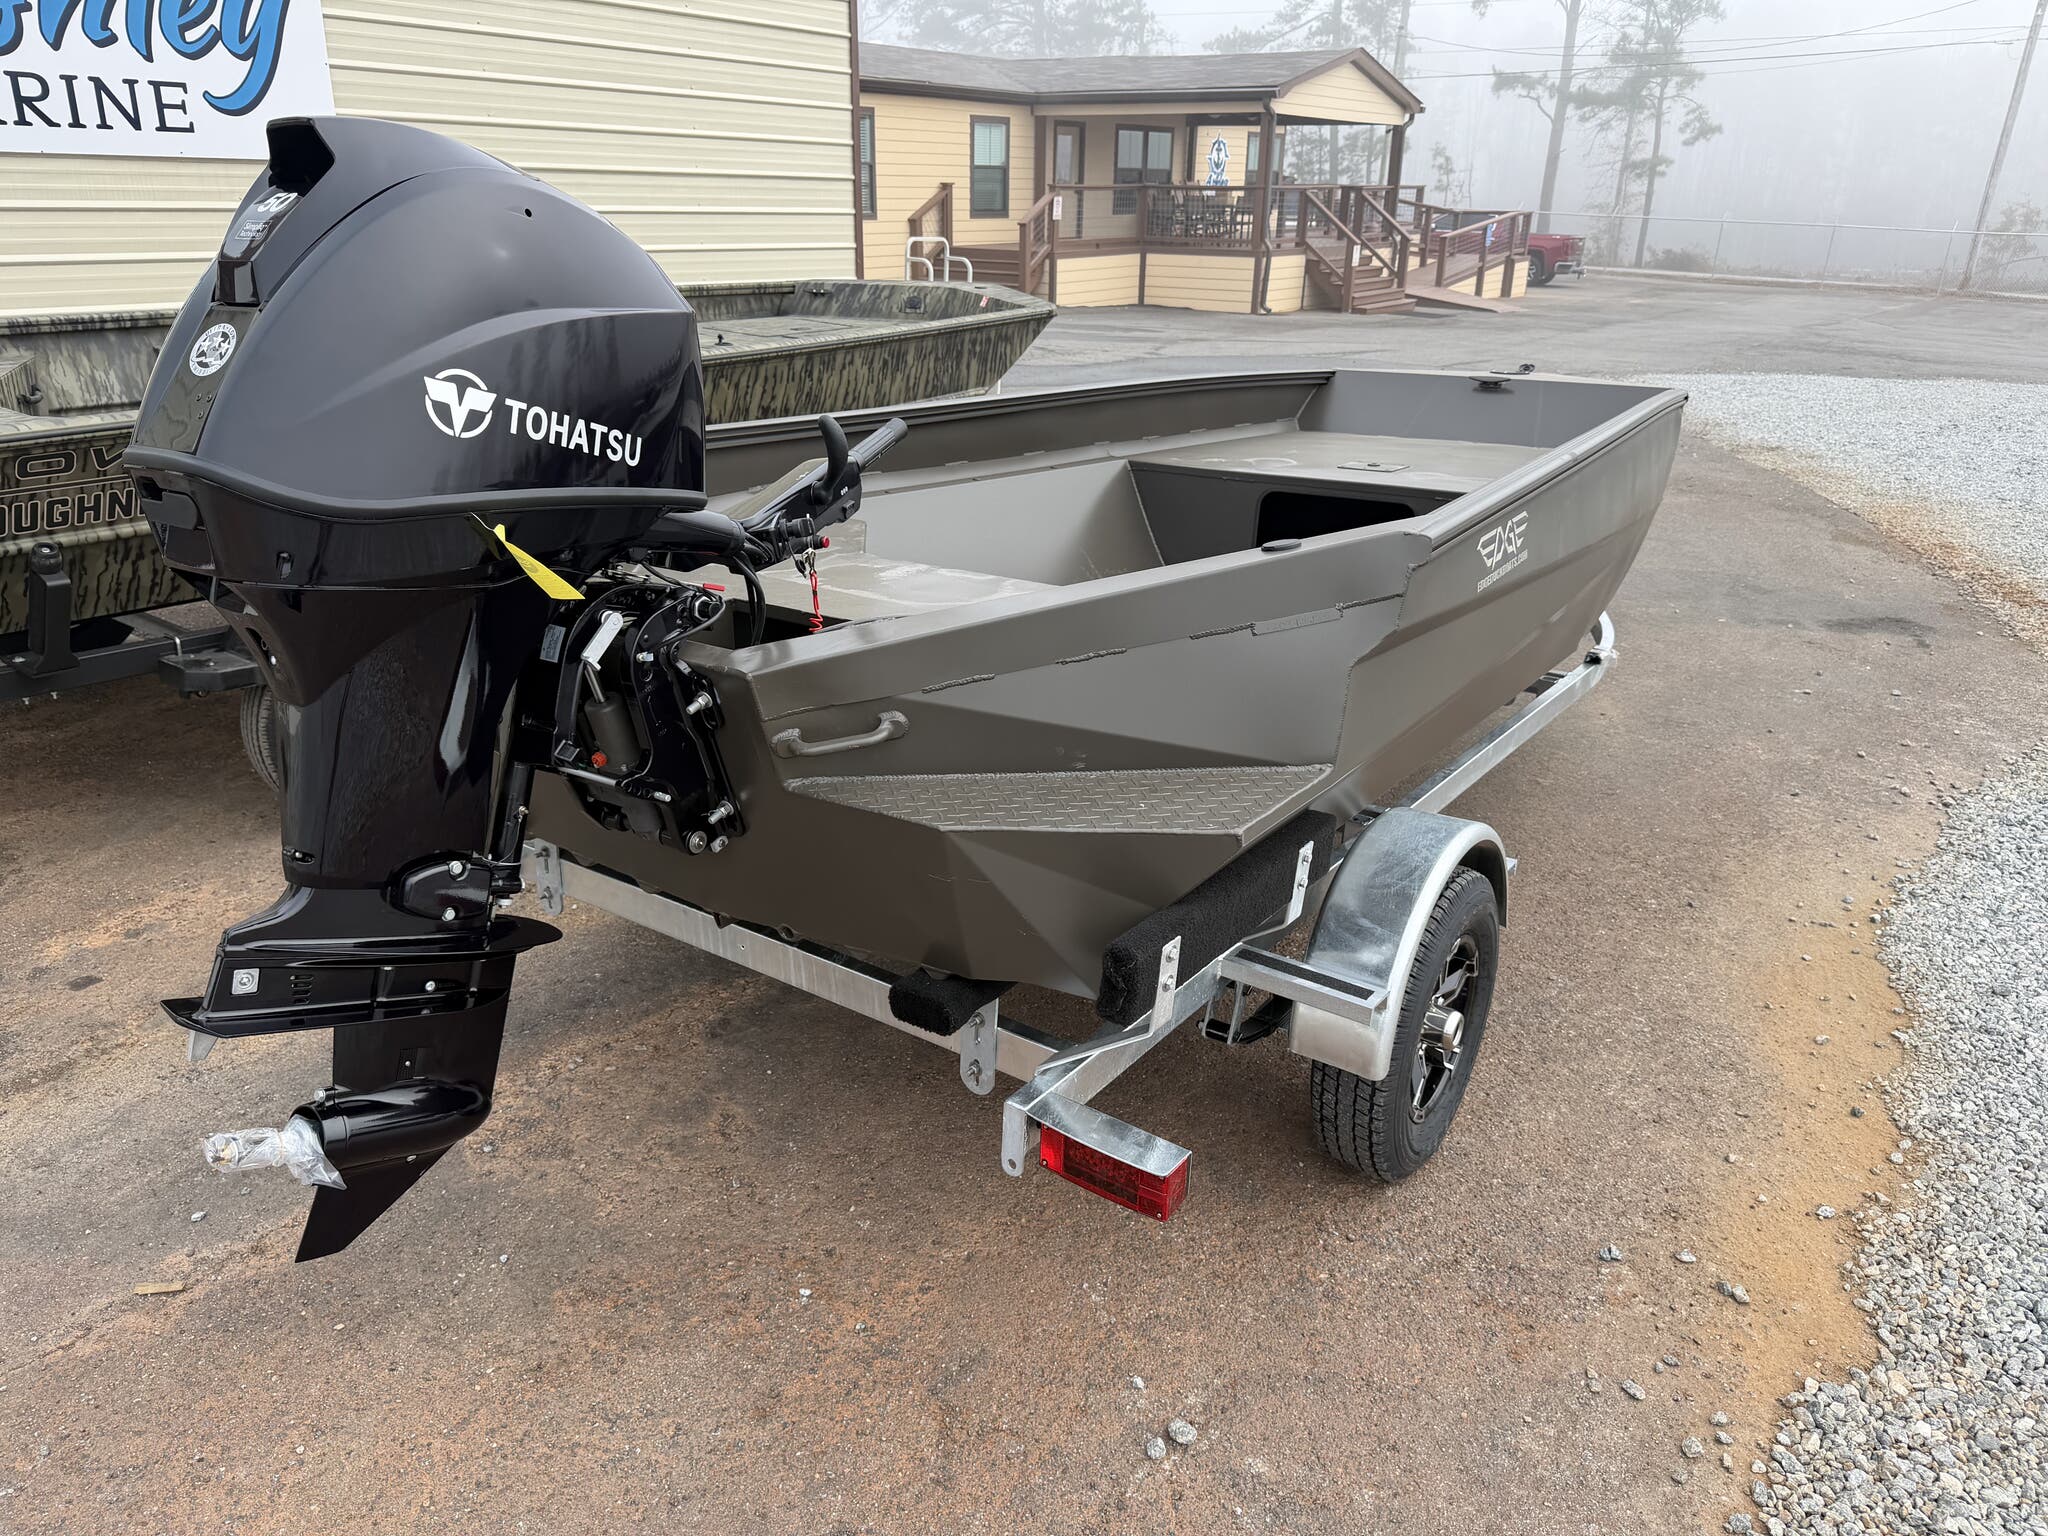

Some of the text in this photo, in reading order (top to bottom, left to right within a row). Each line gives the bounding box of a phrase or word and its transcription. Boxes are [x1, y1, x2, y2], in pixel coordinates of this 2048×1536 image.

[0, 70, 195, 133] RINE
[257, 192, 298, 213] 50
[505, 398, 642, 467] TOHATSU
[0, 487, 146, 537] UGHN
[1476, 510, 1529, 571] EDGE
